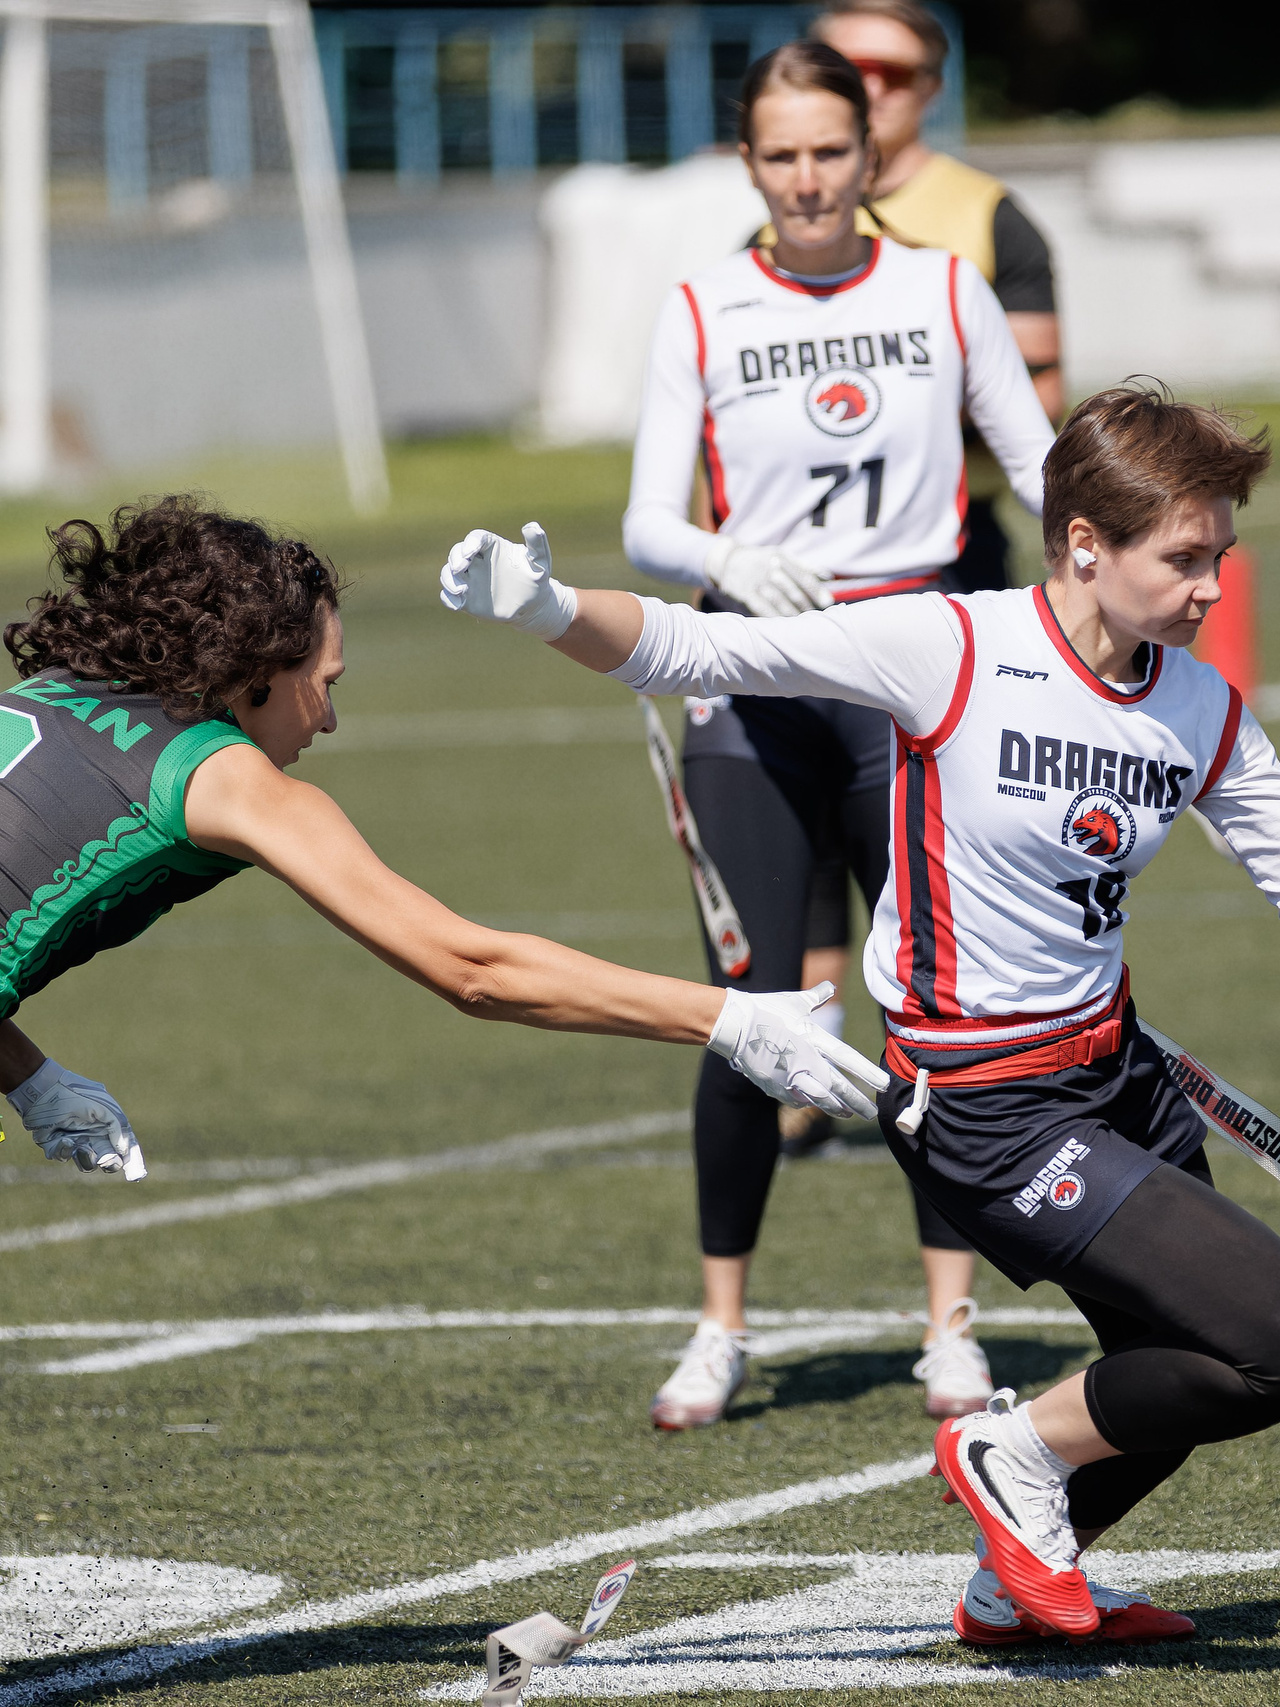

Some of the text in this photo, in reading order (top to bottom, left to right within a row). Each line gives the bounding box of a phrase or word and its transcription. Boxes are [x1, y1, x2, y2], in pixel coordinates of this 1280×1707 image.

[740, 329, 930, 384] DRAGONS
[809, 458, 885, 527] 71
[997, 783, 1046, 801] MOSCOW
[998, 728, 1194, 810] DRAGONS
[1012, 1137, 1087, 1214] DRAGONS
